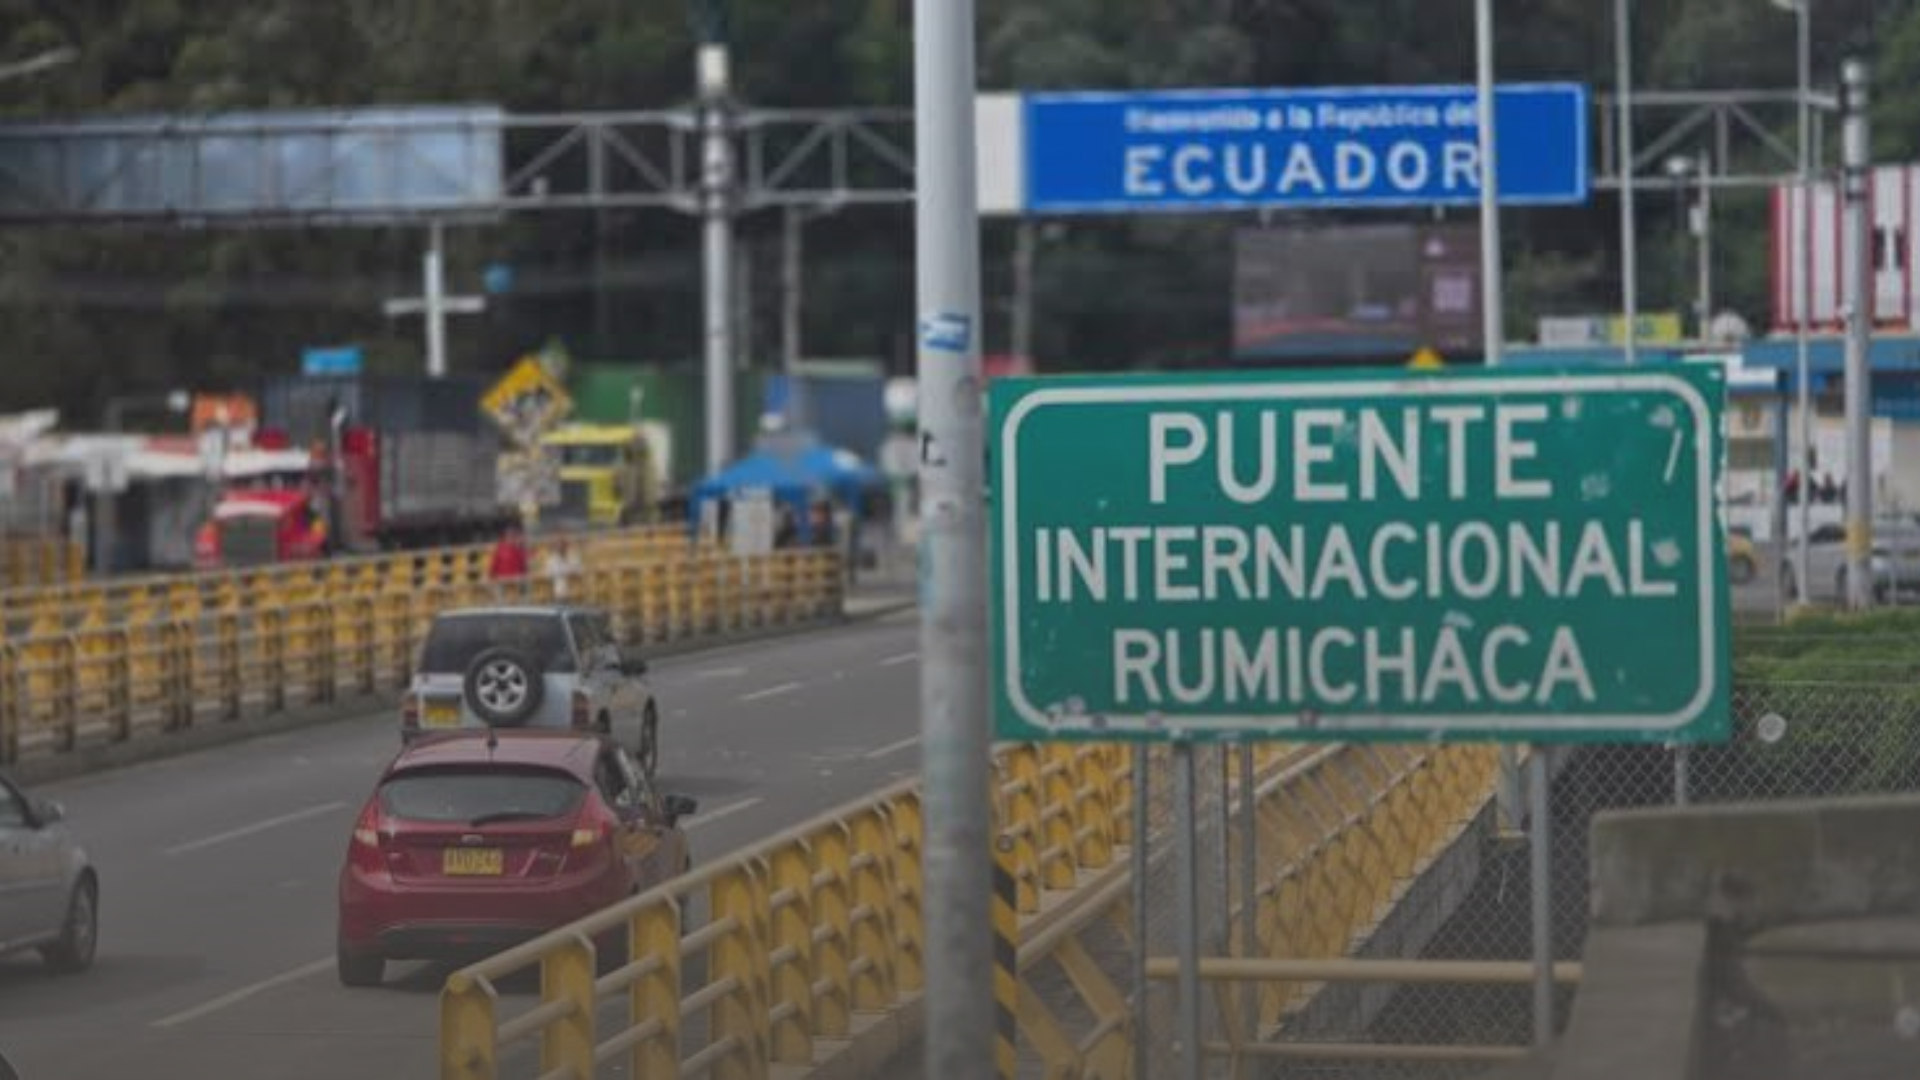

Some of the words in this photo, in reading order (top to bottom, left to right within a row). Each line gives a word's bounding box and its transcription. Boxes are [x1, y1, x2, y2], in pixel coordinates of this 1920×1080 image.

[1125, 142, 1480, 195] ECUADOR
[1148, 404, 1552, 503] PUENTE
[1034, 519, 1677, 602] INTERNACIONAL
[1112, 624, 1596, 704] RUMICHACA
